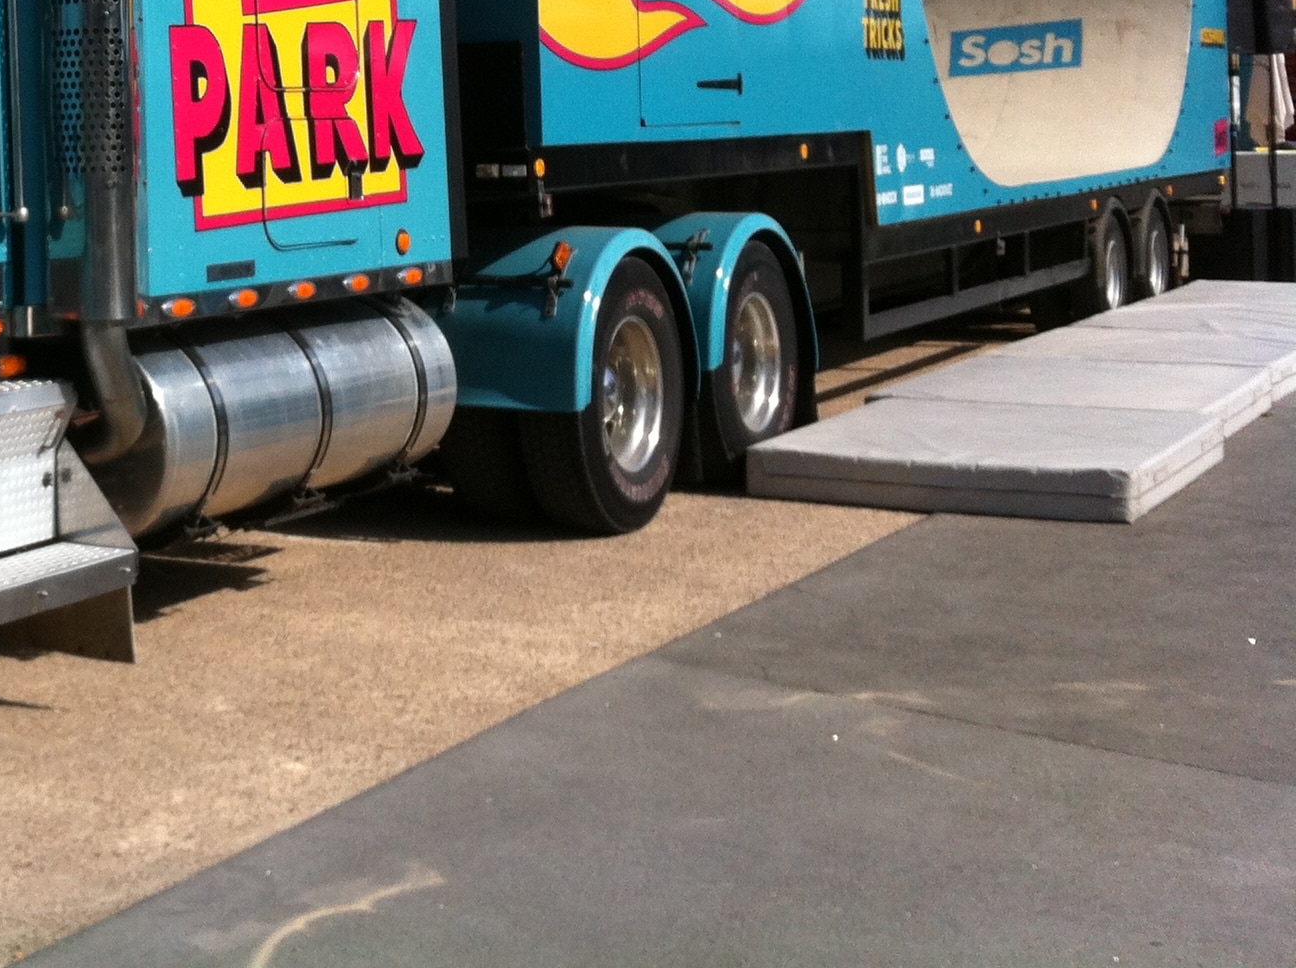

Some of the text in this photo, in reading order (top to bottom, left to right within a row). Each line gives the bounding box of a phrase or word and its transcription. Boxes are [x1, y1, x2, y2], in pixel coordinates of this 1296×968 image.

[862, 16, 903, 51] TRICKS
[957, 32, 1074, 68] Sosh
[168, 19, 425, 194] PARK
